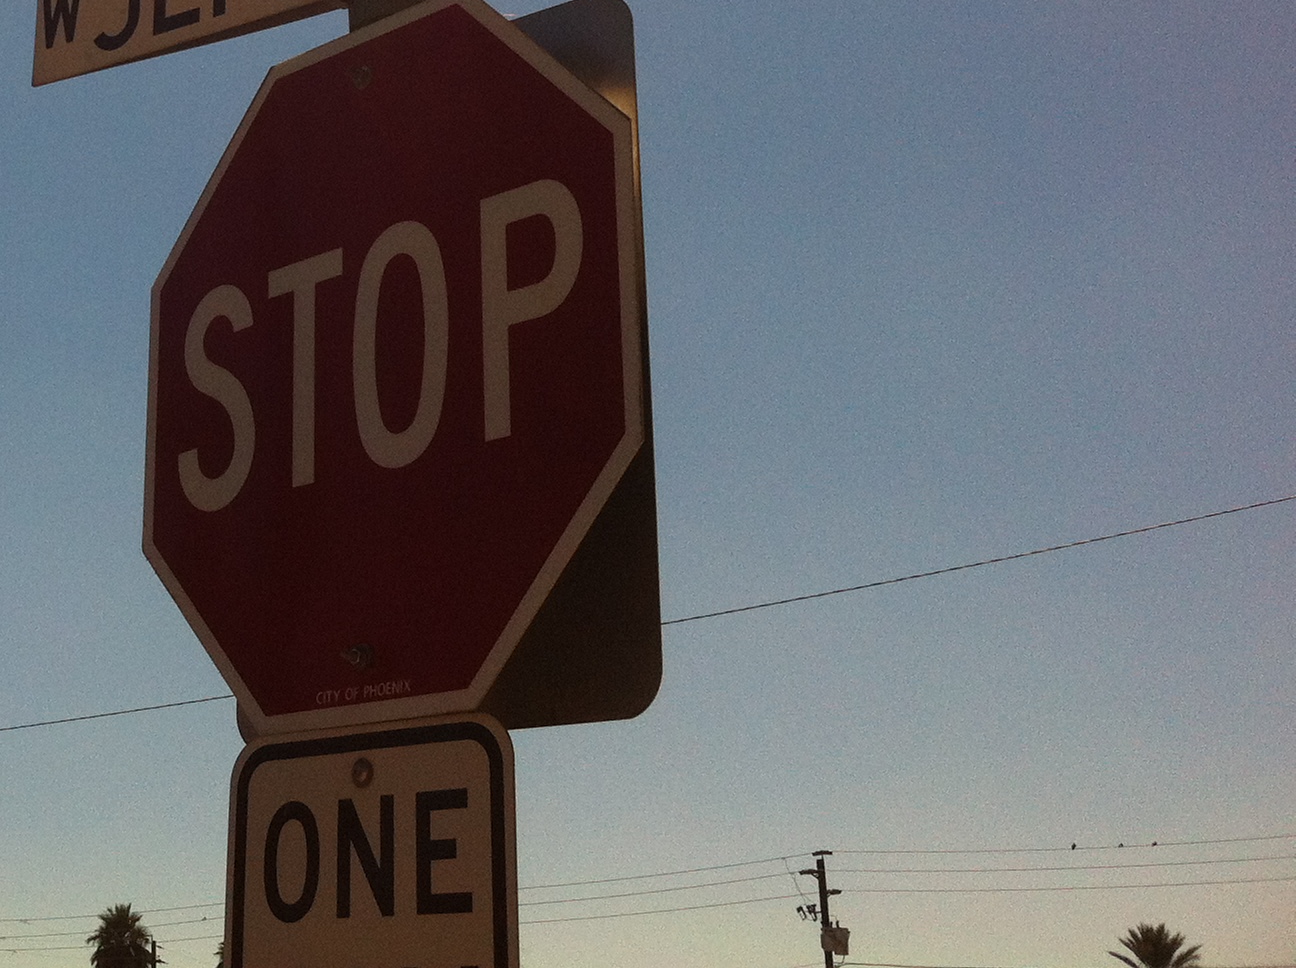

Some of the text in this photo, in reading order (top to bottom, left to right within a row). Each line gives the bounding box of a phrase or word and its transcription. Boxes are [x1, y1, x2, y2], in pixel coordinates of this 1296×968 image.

[177, 178, 584, 513] STOP
[315, 679, 412, 705] CITY OF PHOENIX
[263, 787, 473, 924] ONE
